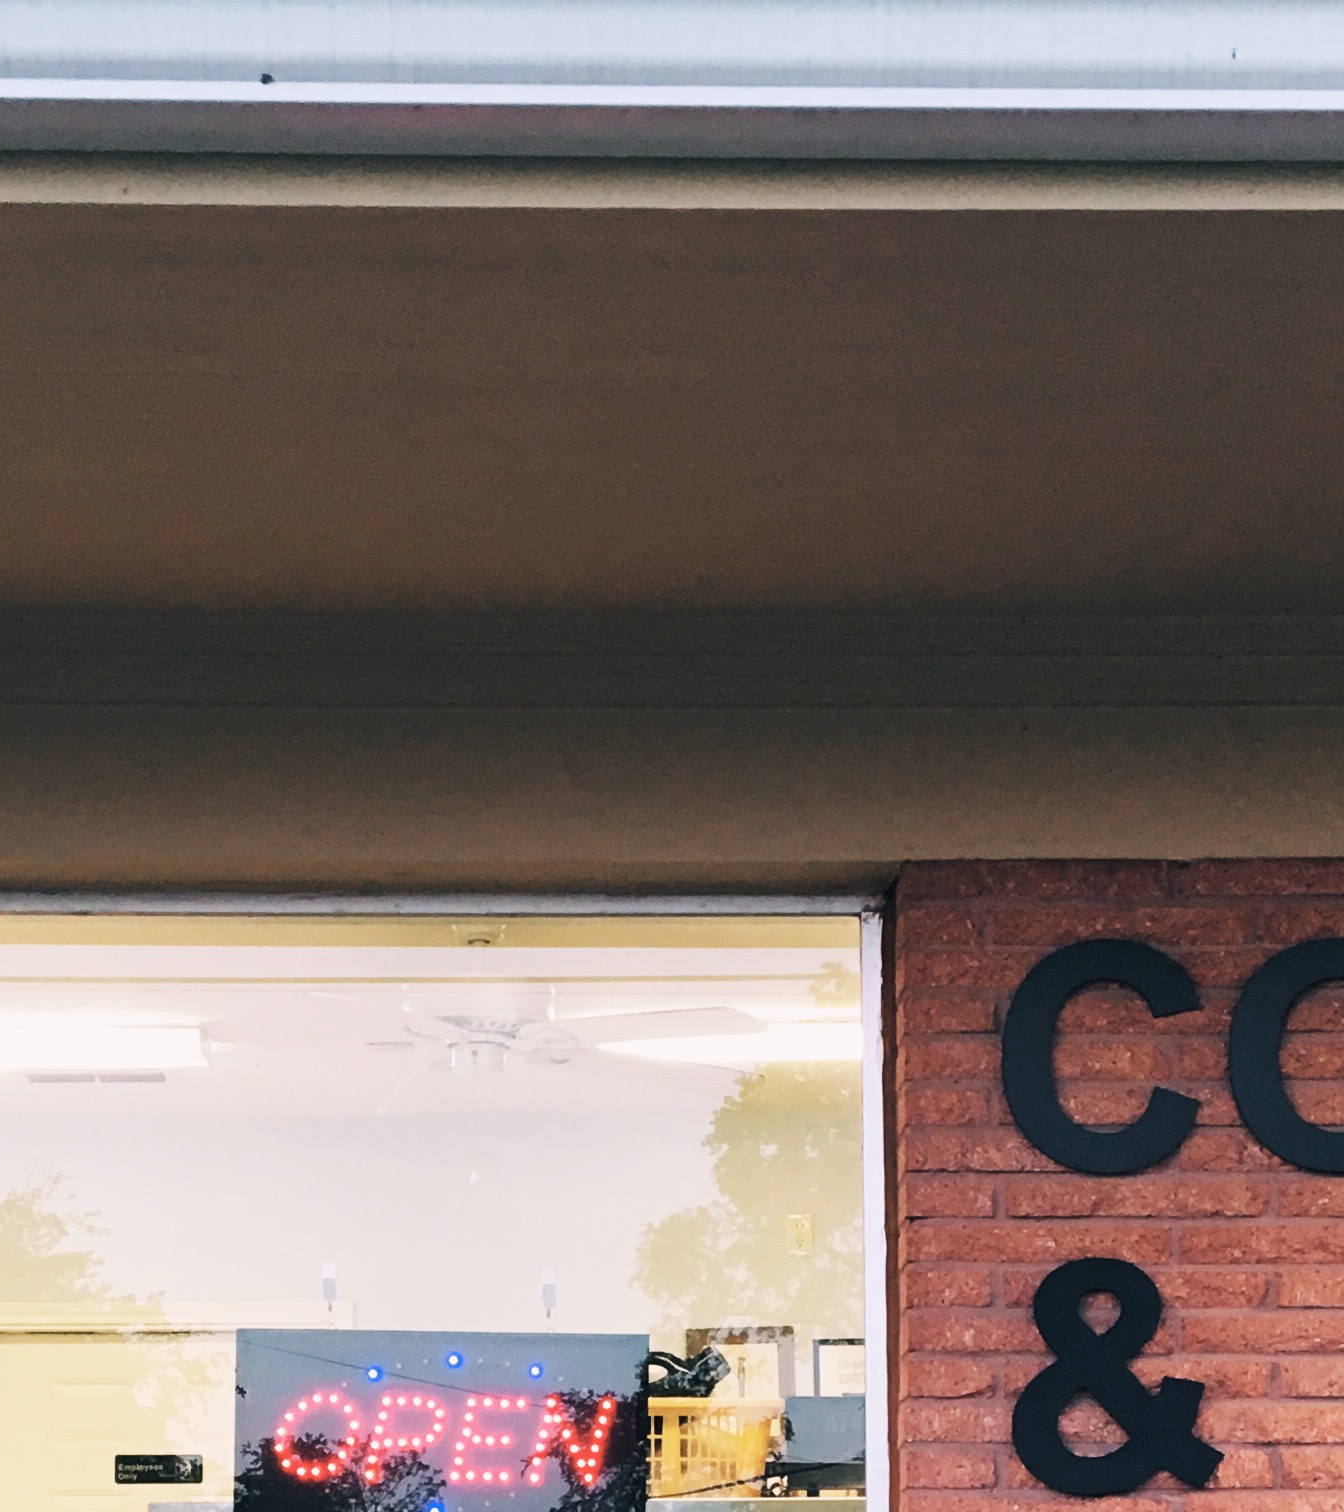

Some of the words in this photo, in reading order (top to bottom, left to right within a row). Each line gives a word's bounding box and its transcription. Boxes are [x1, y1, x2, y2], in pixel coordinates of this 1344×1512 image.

[1012, 1257, 1223, 1499] &
[272, 1390, 616, 1486] OPEN
[117, 1463, 164, 1472] Employees
[117, 1473, 138, 1482] Only
